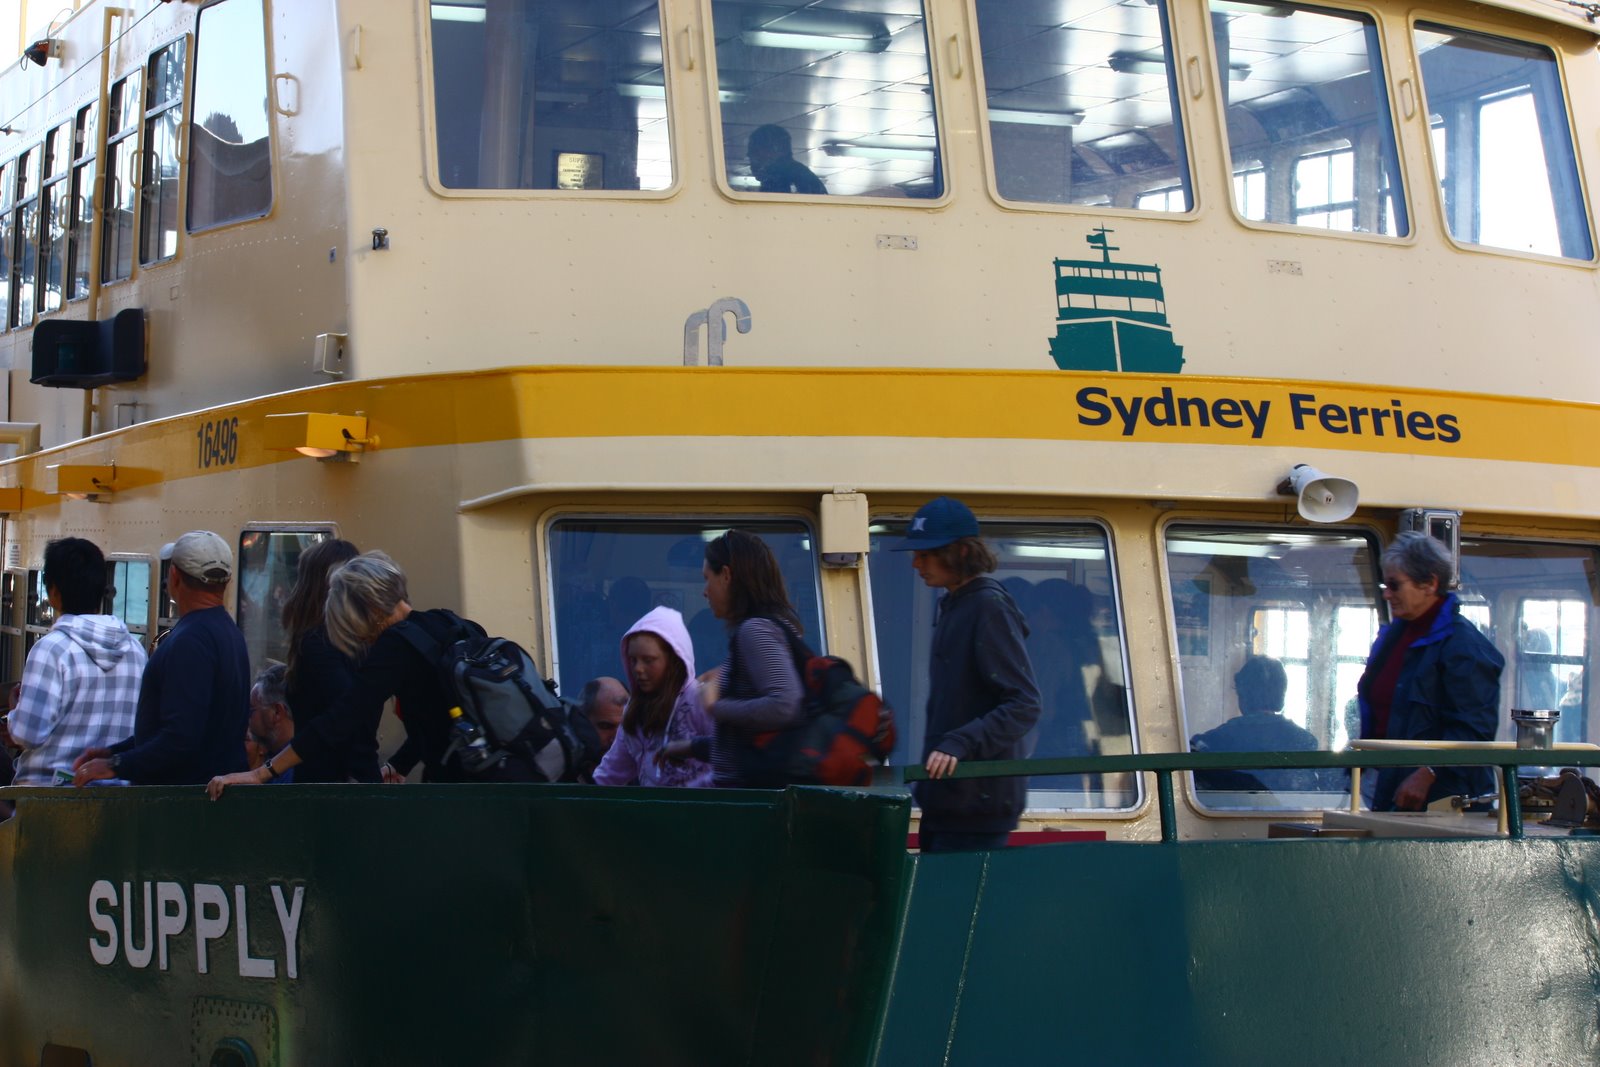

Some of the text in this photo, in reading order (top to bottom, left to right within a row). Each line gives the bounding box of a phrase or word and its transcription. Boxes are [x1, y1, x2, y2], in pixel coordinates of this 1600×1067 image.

[197, 416, 239, 469] 16496
[1075, 386, 1461, 443] Sydney Ferries
[89, 879, 305, 979] SUPPLY
